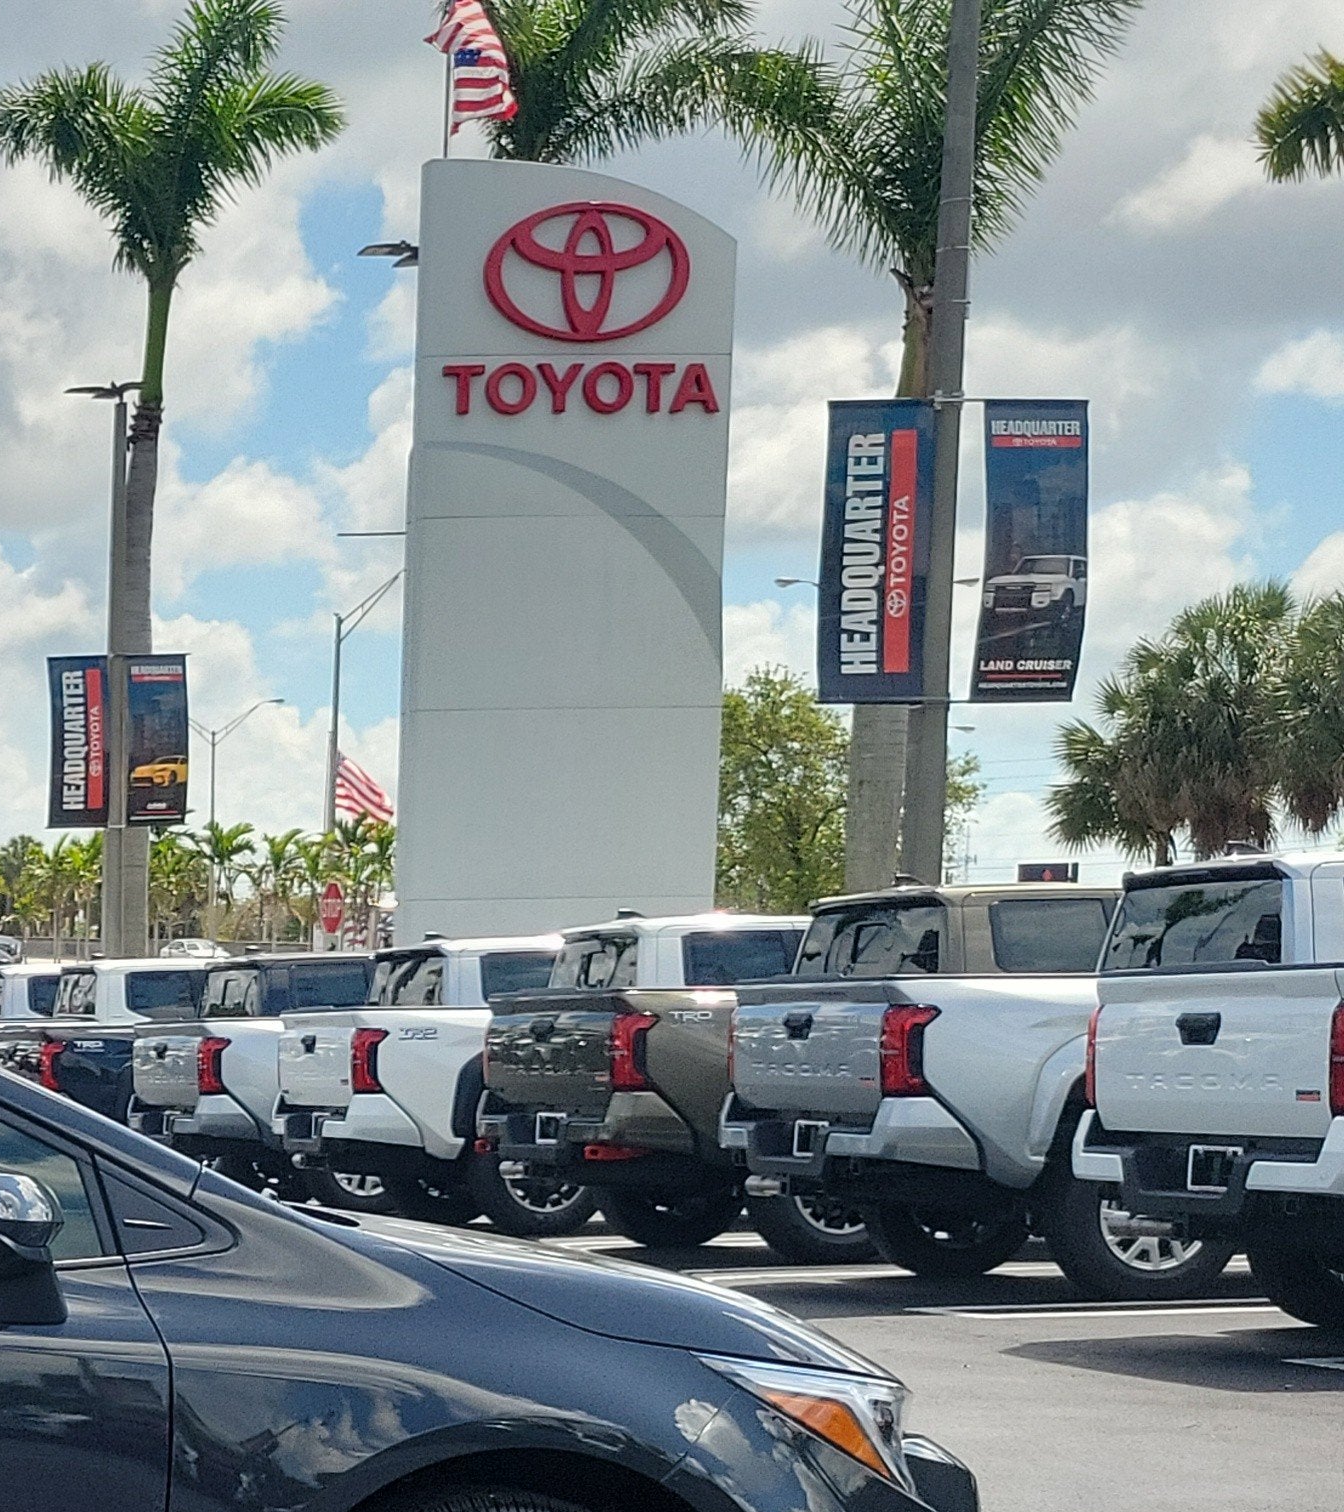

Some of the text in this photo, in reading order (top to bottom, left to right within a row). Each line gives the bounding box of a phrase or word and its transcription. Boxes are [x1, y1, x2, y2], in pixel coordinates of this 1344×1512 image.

[442, 362, 720, 415] TOYOTA
[991, 420, 1080, 437] HEADQUARTER
[840, 432, 885, 674] HEADQUARTER
[890, 495, 909, 587] TOYOTA
[979, 659, 1072, 671] LAND CRUISER
[62, 670, 88, 811] HEADQUARTER
[89, 706, 100, 759] TOYOTA
[668, 1011, 712, 1023] TRD
